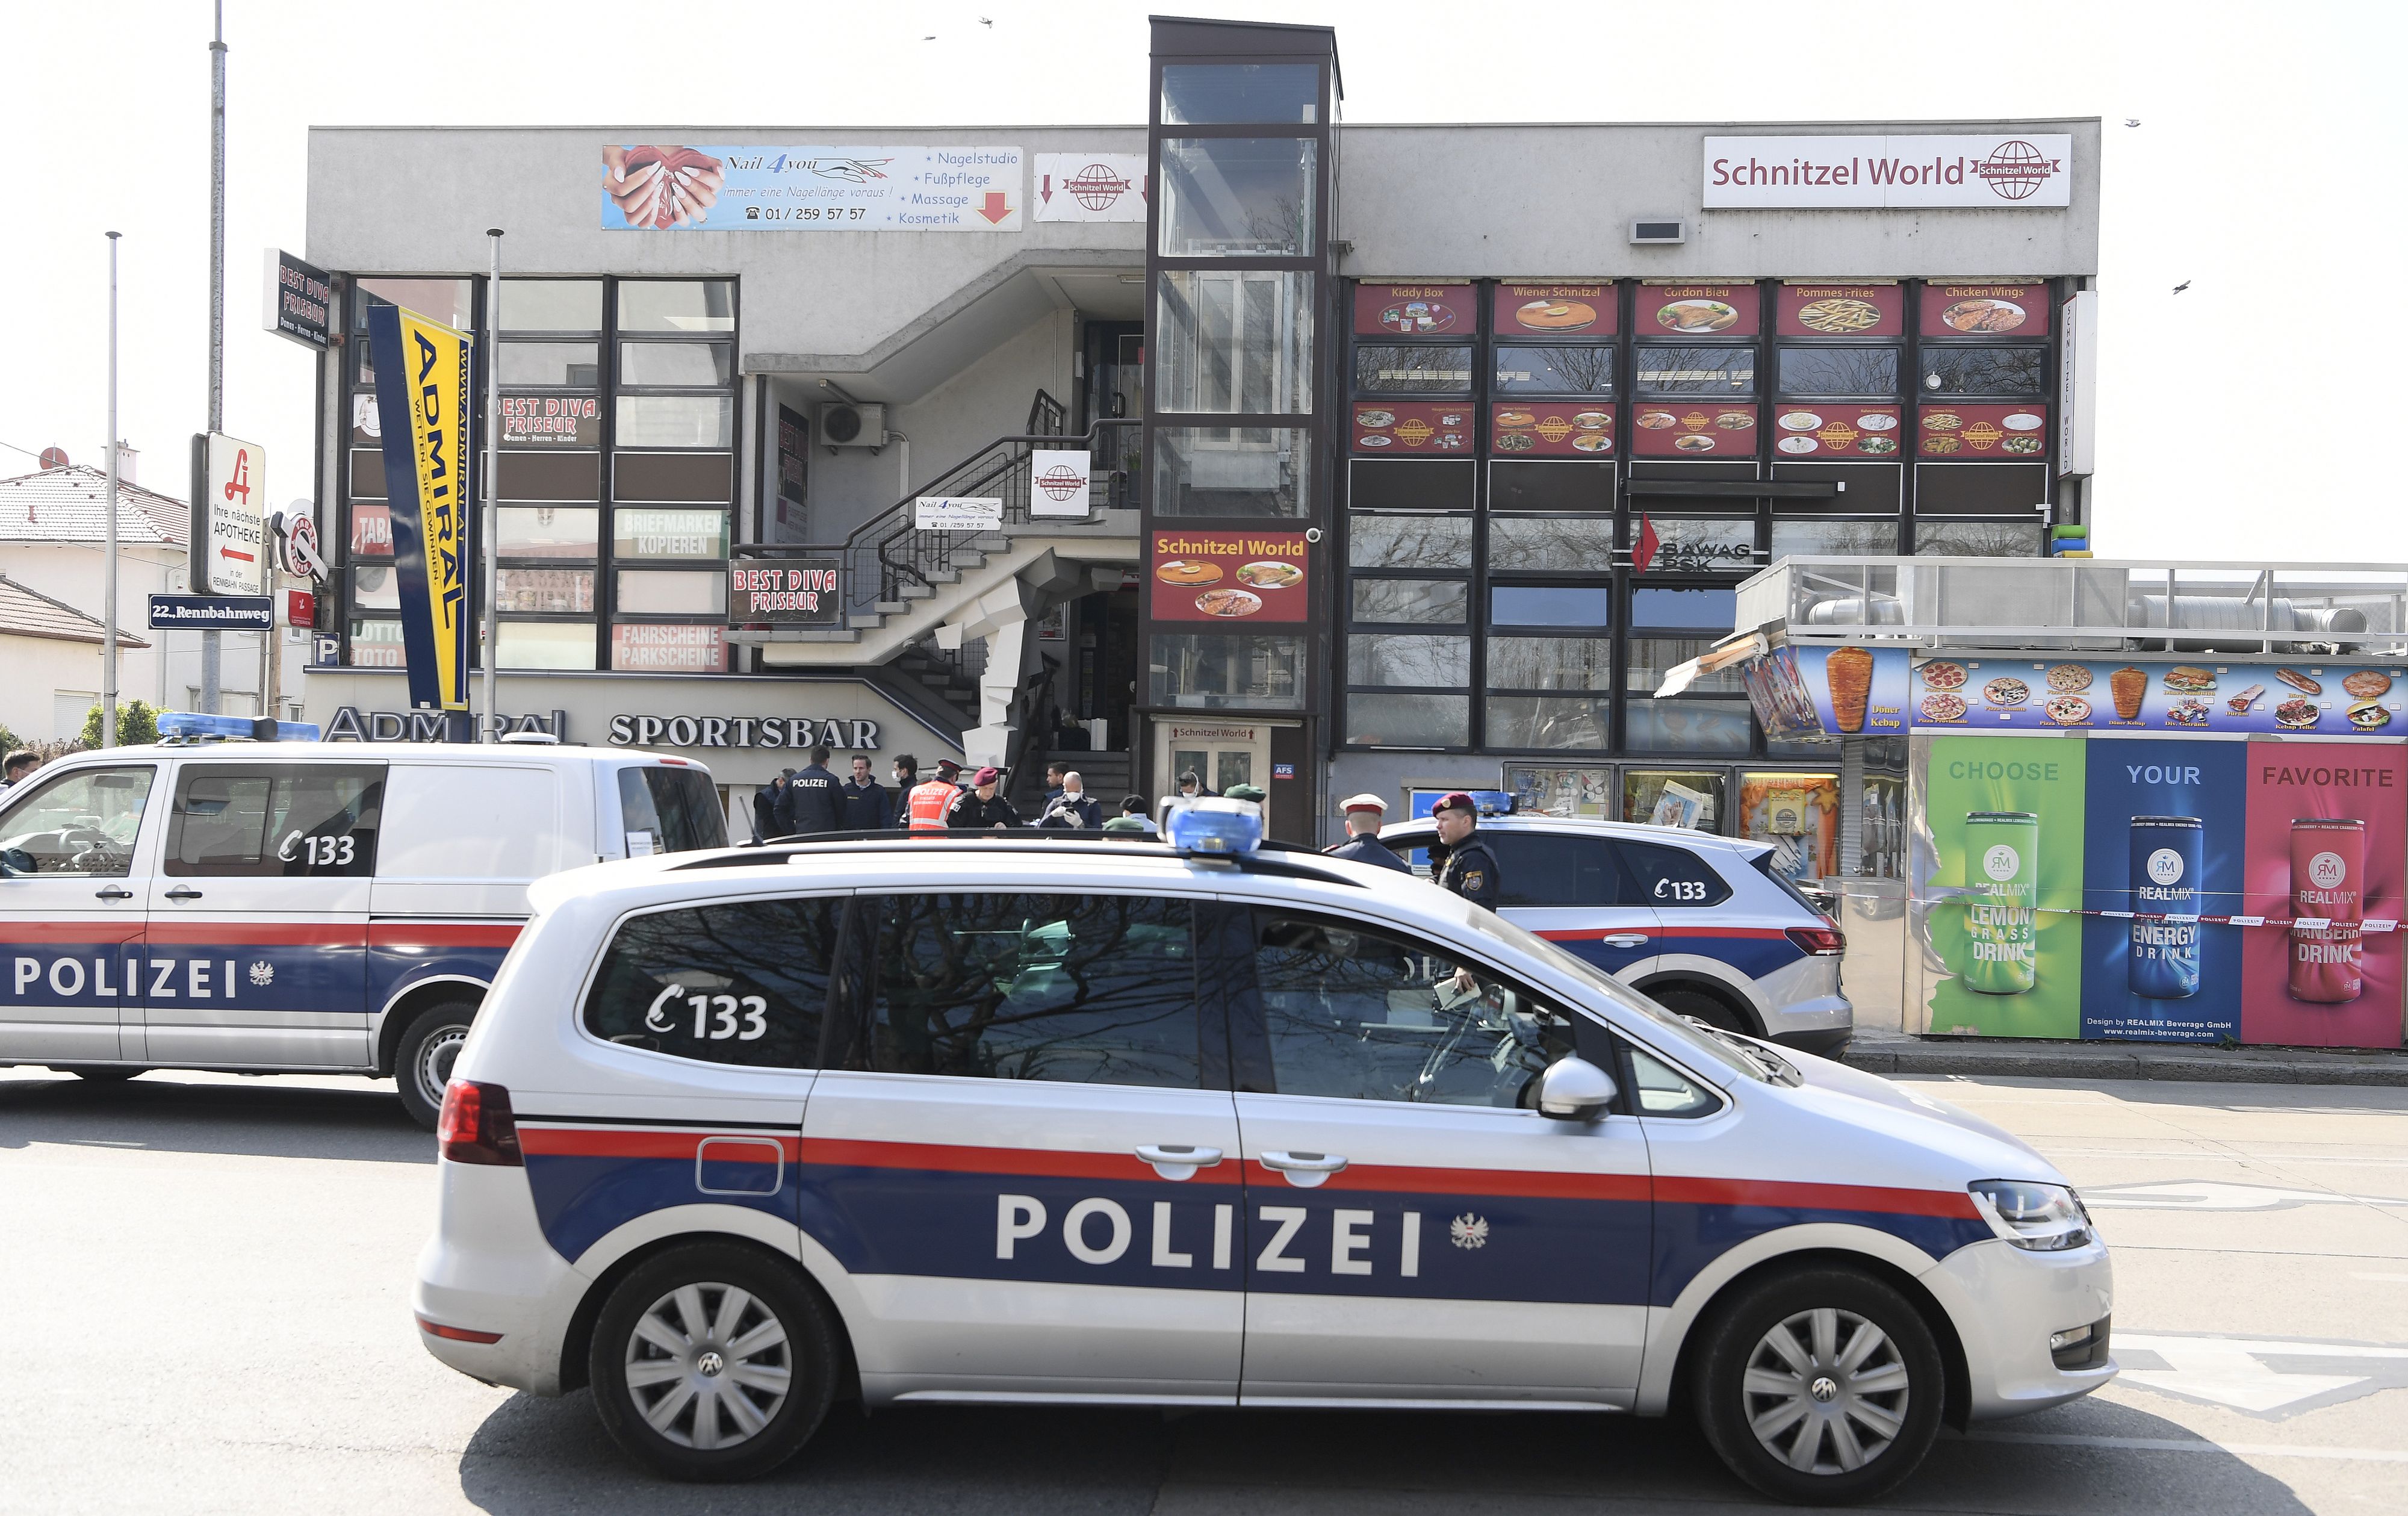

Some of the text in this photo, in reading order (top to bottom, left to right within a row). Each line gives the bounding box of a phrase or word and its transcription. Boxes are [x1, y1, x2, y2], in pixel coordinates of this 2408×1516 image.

[725, 154, 818, 174] Nail 4 you
[937, 152, 1018, 167] Nagelstudio
[1712, 157, 1964, 186] Schnitzel World
[1979, 165, 2051, 176] Schnitzel World
[925, 173, 990, 188] Fußpflege
[724, 187, 756, 197] immer
[760, 187, 782, 197] eine
[786, 186, 845, 200] Nagellänge
[851, 188, 884, 197] voraus
[911, 193, 969, 208] Massage
[766, 208, 781, 220] 01
[796, 208, 820, 220] 259
[827, 208, 844, 220] 57
[849, 208, 866, 220] 57
[899, 213, 959, 224] Kosmetik
[280, 265, 329, 305] BEST DIVA
[1392, 288, 1444, 299] Kiddy Box
[1513, 287, 1601, 297] Wiener Schnitzel
[1664, 287, 1730, 297] Cordon Bleu
[1796, 287, 1875, 298] Pommes Frites
[1945, 287, 2024, 300] Chicken Wings
[284, 290, 325, 328] FRISEUR
[280, 316, 327, 345] Damen Herren Kinder
[545, 399, 596, 418] DIVA
[506, 417, 577, 435] FRISEUR
[414, 328, 465, 630] ADMIRAL
[414, 399, 441, 586] WETTEN. SIE GEWINNEN.
[938, 500, 949, 509] 4
[214, 503, 260, 526] Ihre nächste
[624, 514, 722, 533] BRIEFMARKEN
[214, 521, 261, 544] APOTHEKE
[638, 536, 708, 555] KOPIEREN
[1158, 538, 1305, 556] Schnitzel World
[1662, 542, 1750, 560] BAWAG
[1662, 559, 1713, 573] PSK
[213, 576, 237, 590] RENNBAHN
[733, 570, 837, 594] BEST DIVA
[751, 591, 819, 614] FRISEUR
[622, 626, 719, 645] FAHRSCHEINE
[319, 639, 338, 662] P
[354, 648, 398, 666] TOTO
[621, 647, 719, 666] PARKSCHEINE
[1872, 704, 1900, 714] Döner
[322, 706, 880, 750] ADMRAL SPORTSBAR
[1870, 718, 1901, 728] Kebap
[1180, 728, 1247, 738] Schnitzel World
[1949, 760, 2059, 782] CHOOSE
[2126, 765, 2201, 785] YOUR
[2262, 766, 2394, 788] FAVORITE
[792, 778, 827, 788] POLIZEI
[915, 788, 948, 797] POLIZEI
[304, 836, 355, 865] 133
[1670, 881, 1707, 900] 133
[1970, 906, 2029, 926] LEMON
[1971, 927, 2029, 940] GRASS
[2133, 924, 2197, 945] ENERGY
[1973, 941, 2027, 961] DRINK
[2136, 945, 2192, 960] DRINK
[2298, 943, 2354, 963] DRINK
[15, 957, 236, 998] POLIZEI
[687, 995, 768, 1040] 133
[2104, 1028, 2214, 1038] www.realmix-beverage.com
[996, 1194, 1421, 1278] POLIZEI
